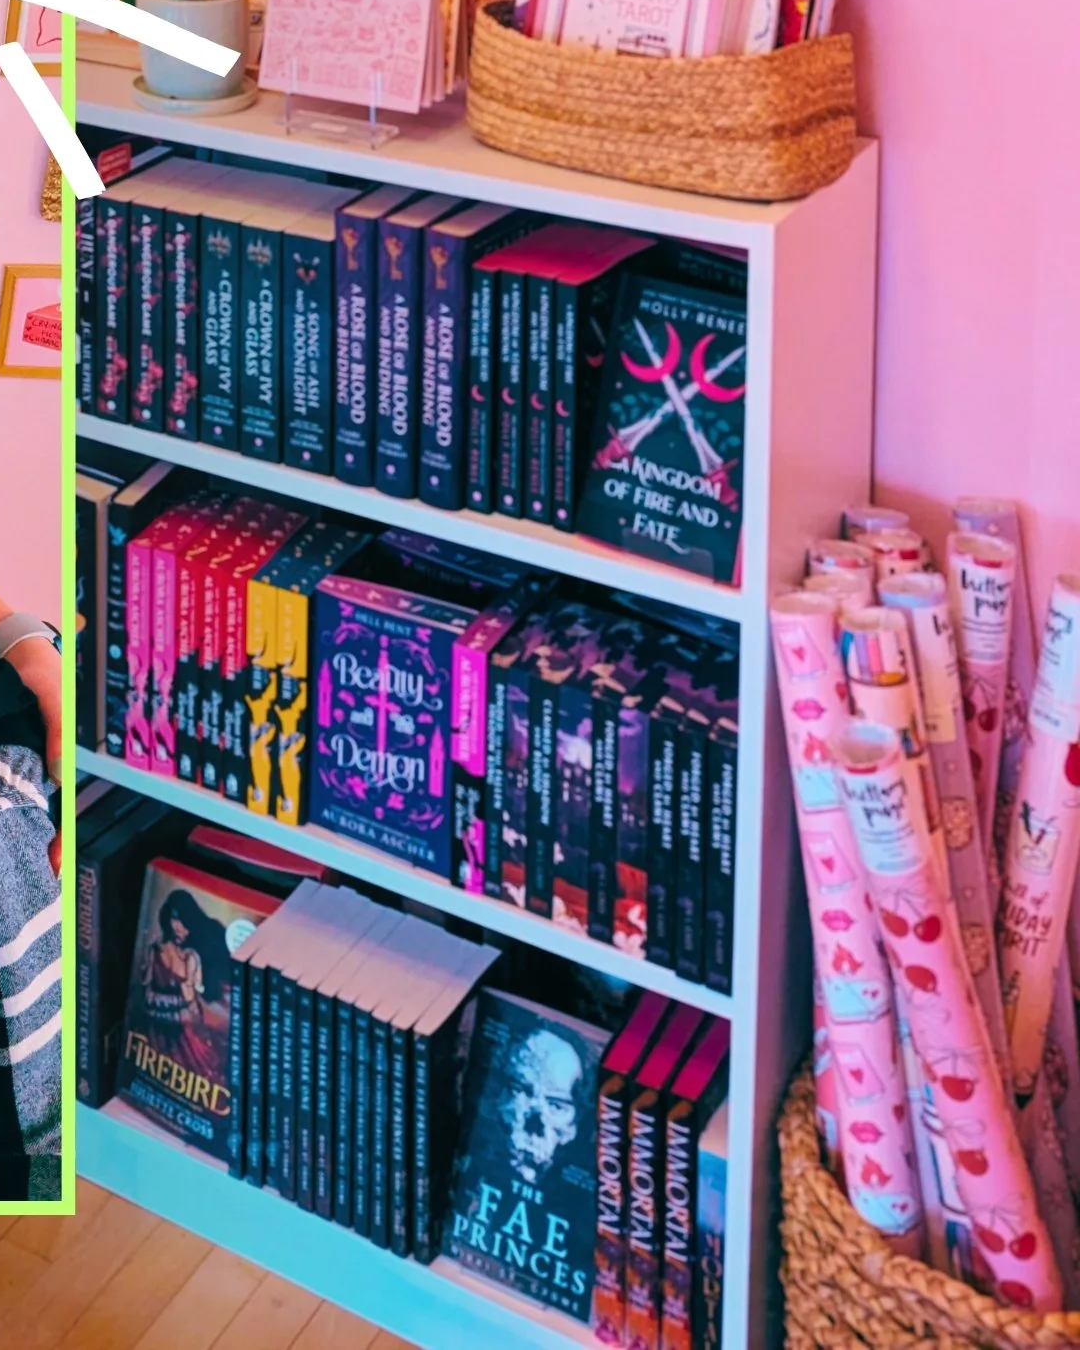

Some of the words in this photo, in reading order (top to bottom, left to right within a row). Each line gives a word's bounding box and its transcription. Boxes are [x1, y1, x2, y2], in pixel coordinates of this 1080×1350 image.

[219, 279, 232, 352] CROWN
[351, 283, 362, 294] A
[395, 293, 406, 304] A
[439, 304, 451, 313] A
[205, 318, 217, 366] GLASS
[259, 289, 273, 357] CROWN
[350, 297, 366, 340] ROSE
[394, 307, 409, 350] ROSE
[438, 316, 454, 362] ROSE
[639, 298, 690, 321] HOLLY
[696, 311, 746, 336] RENEE
[218, 365, 231, 393] IVY
[245, 327, 258, 376] GLASS
[337, 328, 349, 405] BINDING
[378, 337, 392, 417] BINDING
[259, 375, 272, 404] IVY
[350, 362, 366, 424] BLOOD
[392, 374, 408, 436] BLOOD
[423, 347, 436, 427] BINDING
[436, 385, 452, 447] BLOOD
[603, 478, 632, 500] OF
[633, 486, 675, 516] FIRE
[676, 501, 719, 528] AND
[631, 455, 721, 500] KINGDOM
[632, 512, 690, 554] FATE
[78, 864, 96, 951] FIREBIRD
[125, 1030, 231, 1116] FIREBIRD
[511, 1180, 544, 1205] THE
[597, 1095, 623, 1235] IMMORTAL
[630, 1110, 656, 1252] IMMORTAL
[665, 1120, 691, 1264] IMMORTAL
[476, 1182, 569, 1259] FAE
[453, 1212, 586, 1295] PRINCES
